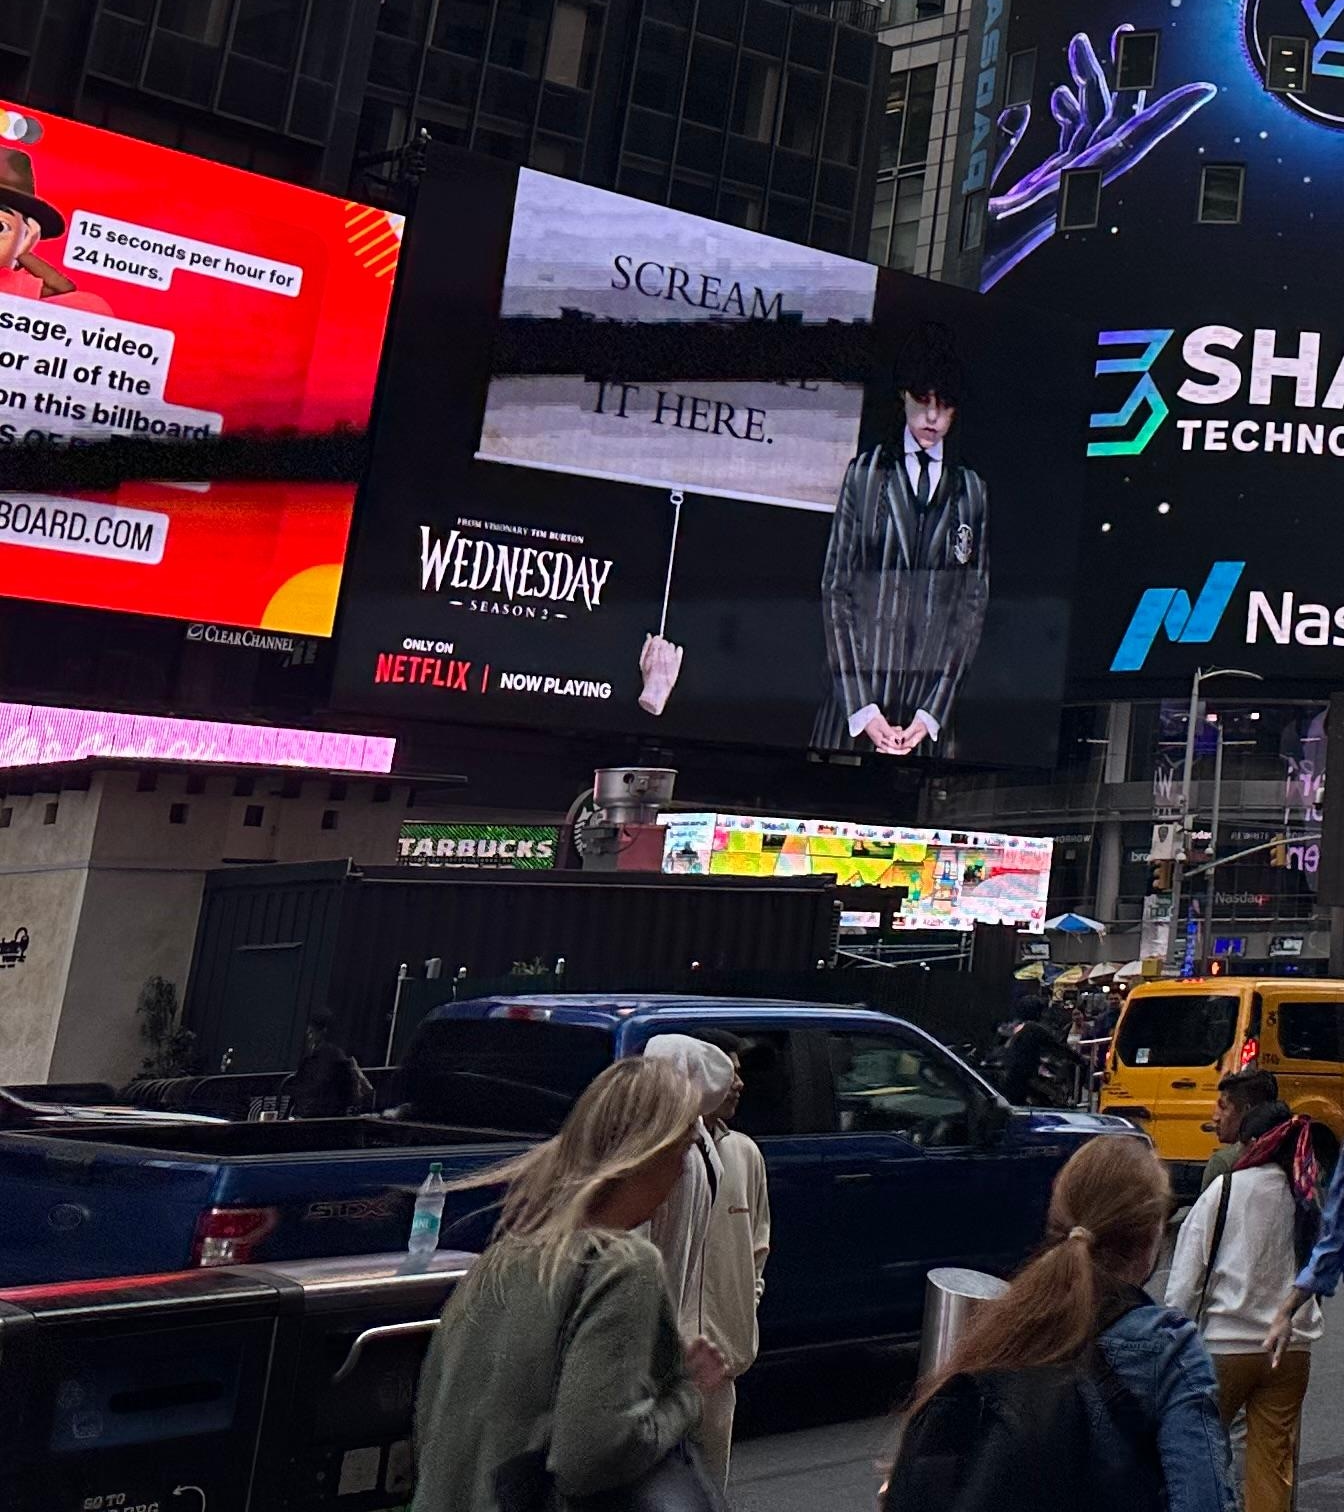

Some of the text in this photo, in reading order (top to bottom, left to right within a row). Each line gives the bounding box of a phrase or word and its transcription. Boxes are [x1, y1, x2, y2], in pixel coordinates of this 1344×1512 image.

[72, 245, 164, 282] 24 hours.
[79, 220, 295, 288] 15 seconds per hour for
[611, 254, 784, 320] SCREAM
[81, 328, 161, 367] video,
[0, 349, 152, 396] or all of the
[34, 392, 86, 422] this
[593, 380, 774, 445] IT HERE.
[456, 517, 585, 545] FROM VISIONARY TIM BURTON
[419, 525, 614, 612] WEDNESDAY
[469, 599, 536, 619] SEASON
[402, 637, 454, 654] ONLY ON
[374, 653, 472, 692] NETFLIX
[500, 673, 612, 699] NOW PLAYING
[1214, 891, 1264, 906] Nasdaq
[104, 1492, 126, 1507] TO
